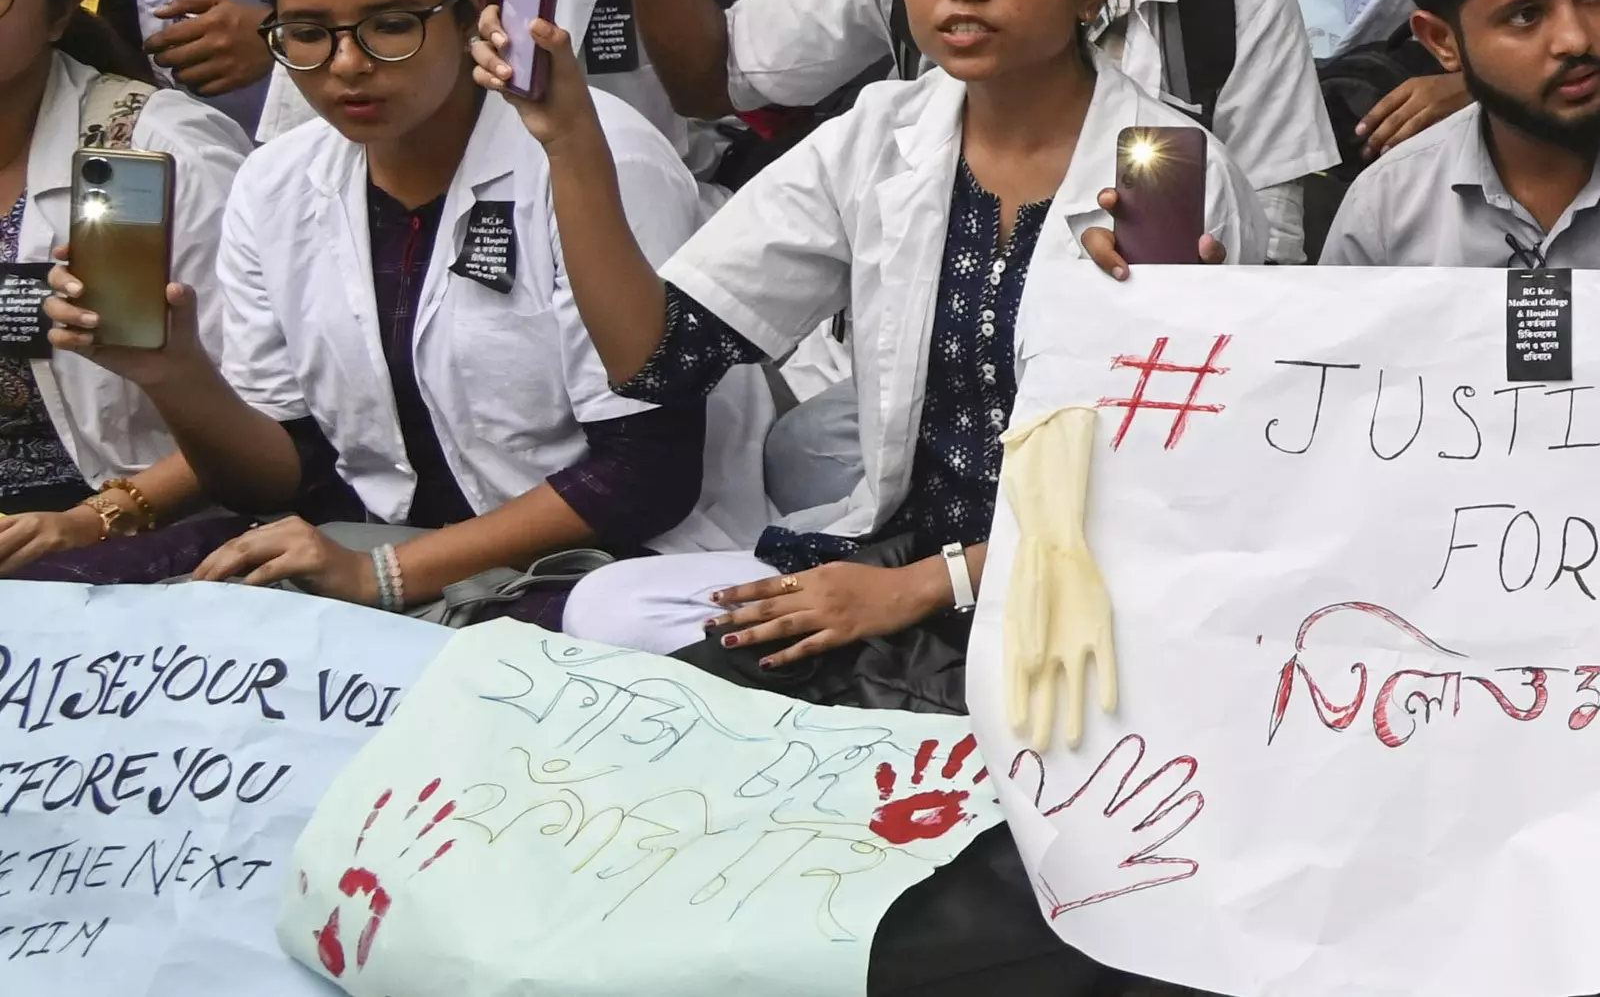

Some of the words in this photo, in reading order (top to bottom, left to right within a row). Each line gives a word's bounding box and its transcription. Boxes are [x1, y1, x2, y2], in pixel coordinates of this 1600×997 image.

[1508, 298, 1538, 307] Medical
[1539, 298, 1569, 308] College
[1516, 309, 1524, 317] &
[1526, 309, 1559, 319] Hospital
[1538, 287, 1554, 295] Kar
[1431, 504, 1598, 600] FOR
[119, 644, 289, 721] YOUR
[316, 667, 402, 728] VOI
[148, 745, 292, 816] YOU
[27, 838, 128, 896] THE
[121, 830, 273, 898] NEXT
